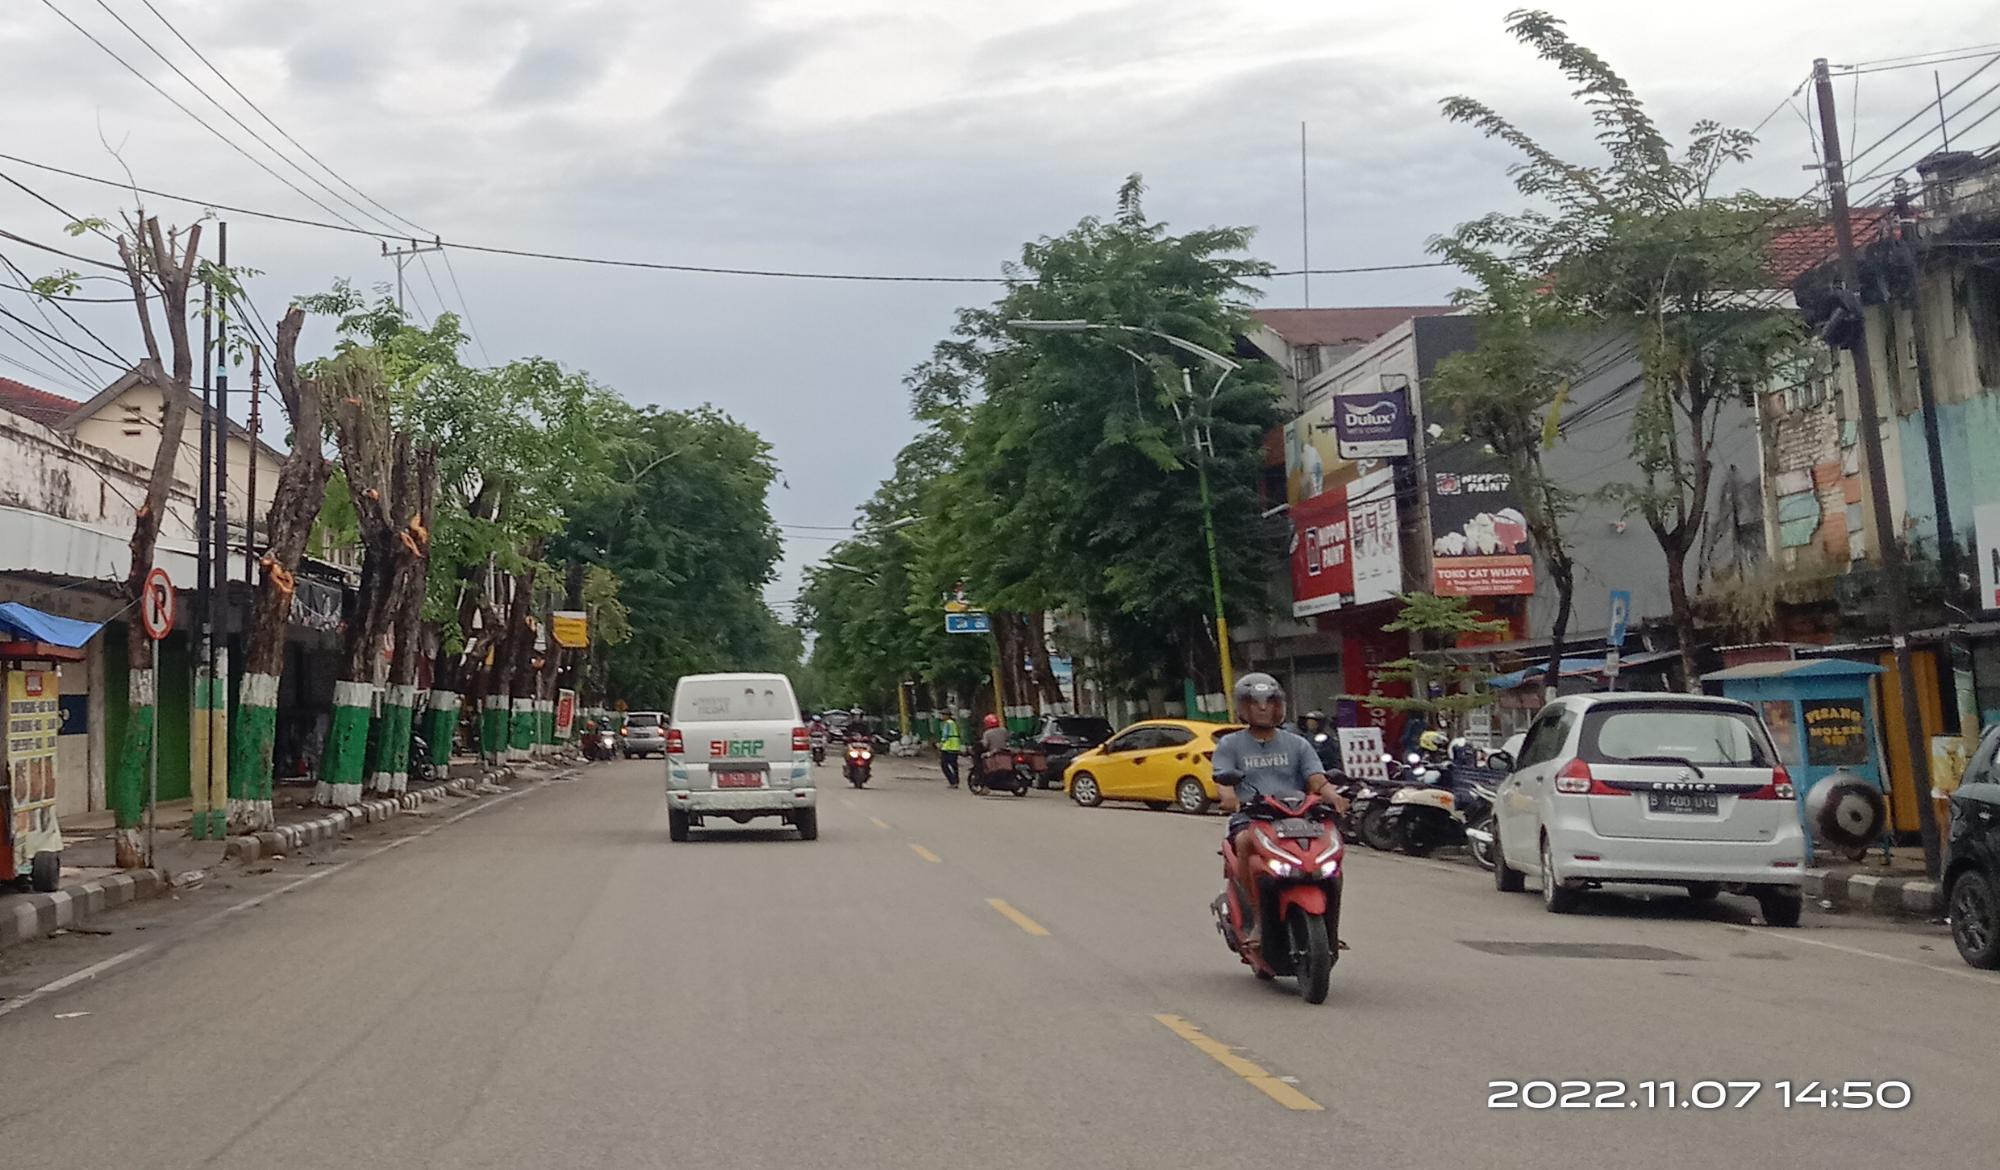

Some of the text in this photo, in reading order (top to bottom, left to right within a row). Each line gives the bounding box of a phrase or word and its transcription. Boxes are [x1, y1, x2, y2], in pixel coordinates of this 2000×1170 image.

[1344, 413, 1391, 427] Dulux
[1467, 482, 1510, 493] PAINT
[1437, 567, 1530, 579] TOKO CAT WIJAYA
[1805, 707, 1862, 724] PISANG
[710, 740, 764, 756] SIGAP
[1245, 754, 1289, 768] HEAVEN
[1650, 793, 1659, 806] B
